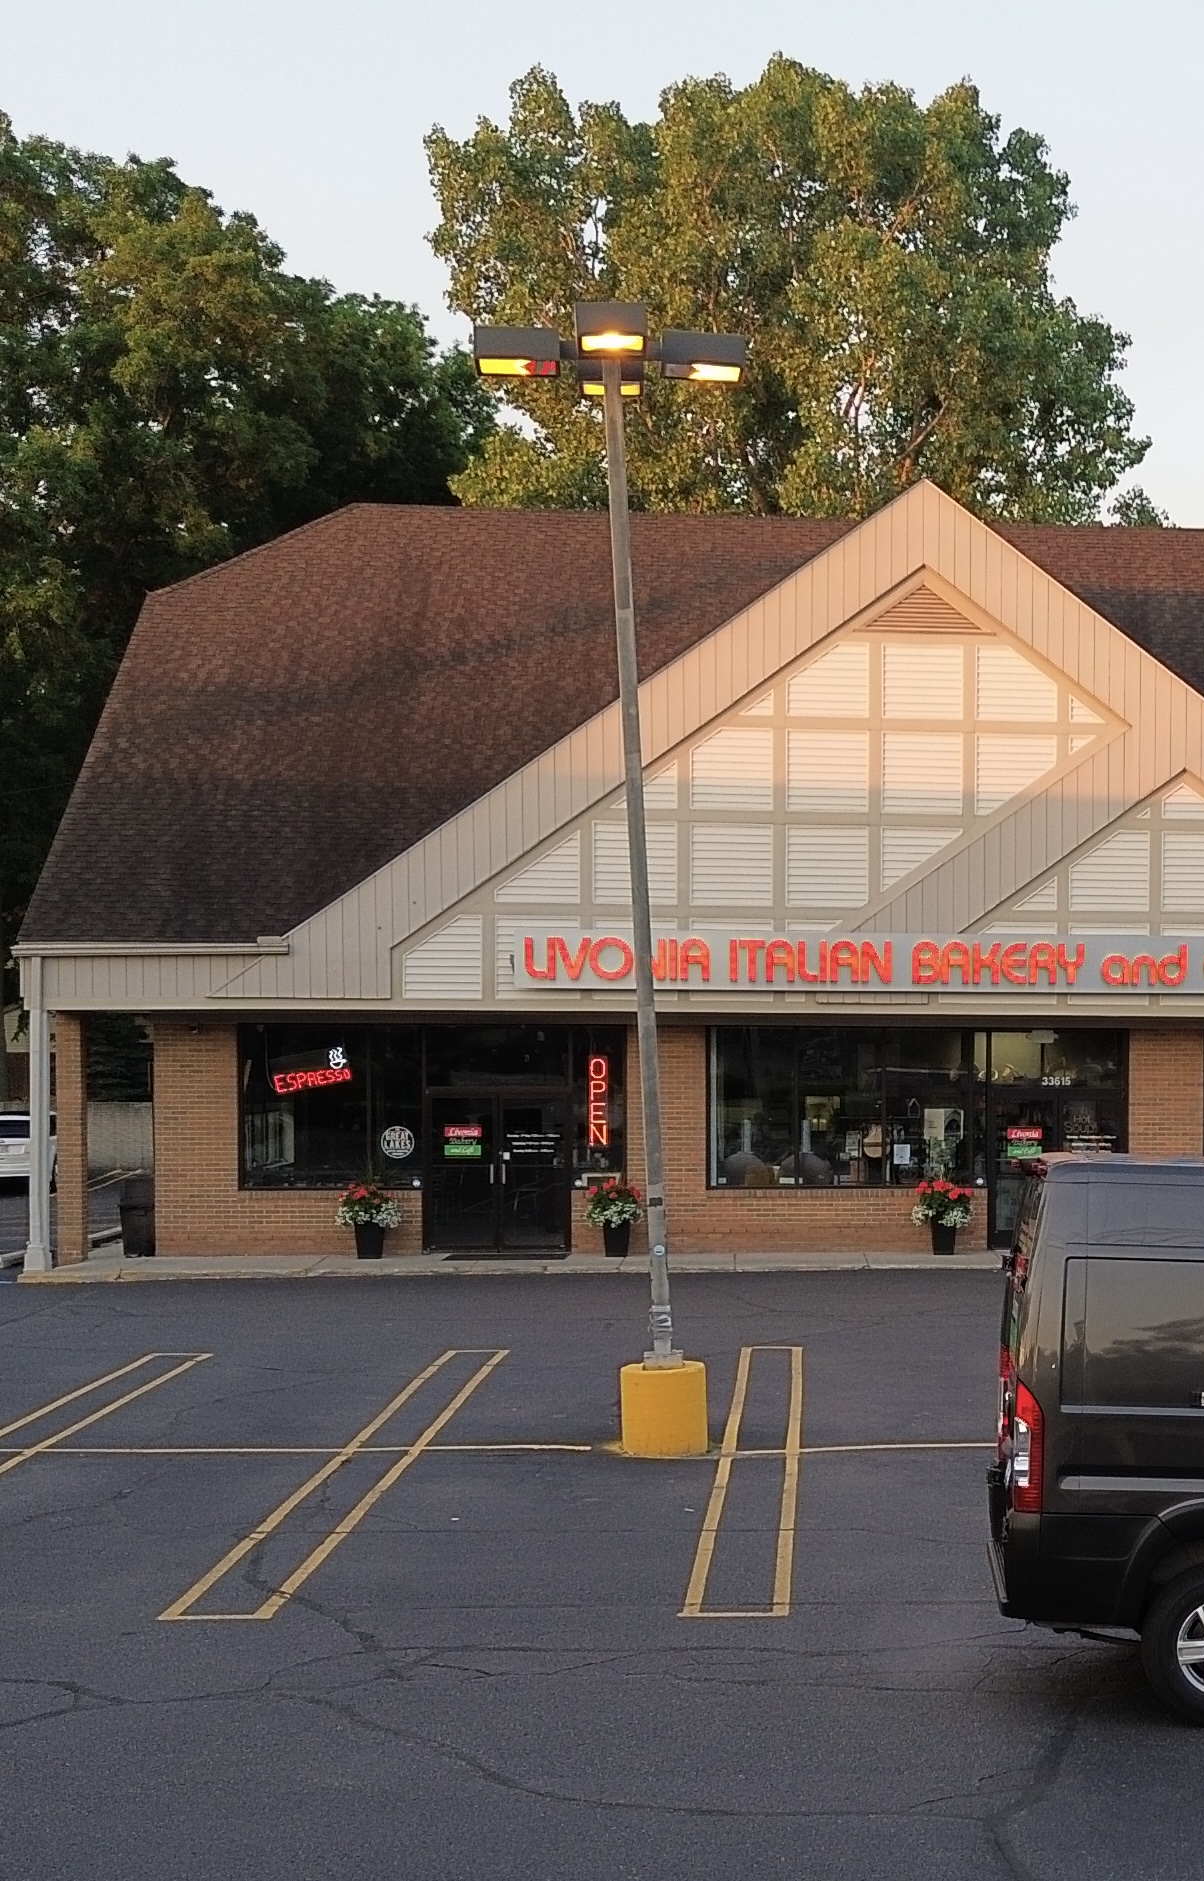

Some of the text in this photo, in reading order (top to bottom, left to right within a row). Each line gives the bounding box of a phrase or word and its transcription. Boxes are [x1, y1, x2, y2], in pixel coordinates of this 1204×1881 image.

[729, 938, 893, 984] ITALIAN
[912, 941, 1085, 986] BAKERY
[1101, 944, 1188, 986] and
[273, 1068, 352, 1094] ESPRESSO
[1041, 1076, 1071, 1086] 33615
[589, 1058, 607, 1146] OPEN
[384, 1140, 411, 1149] LAKES
[385, 1132, 409, 1141] GREAT
